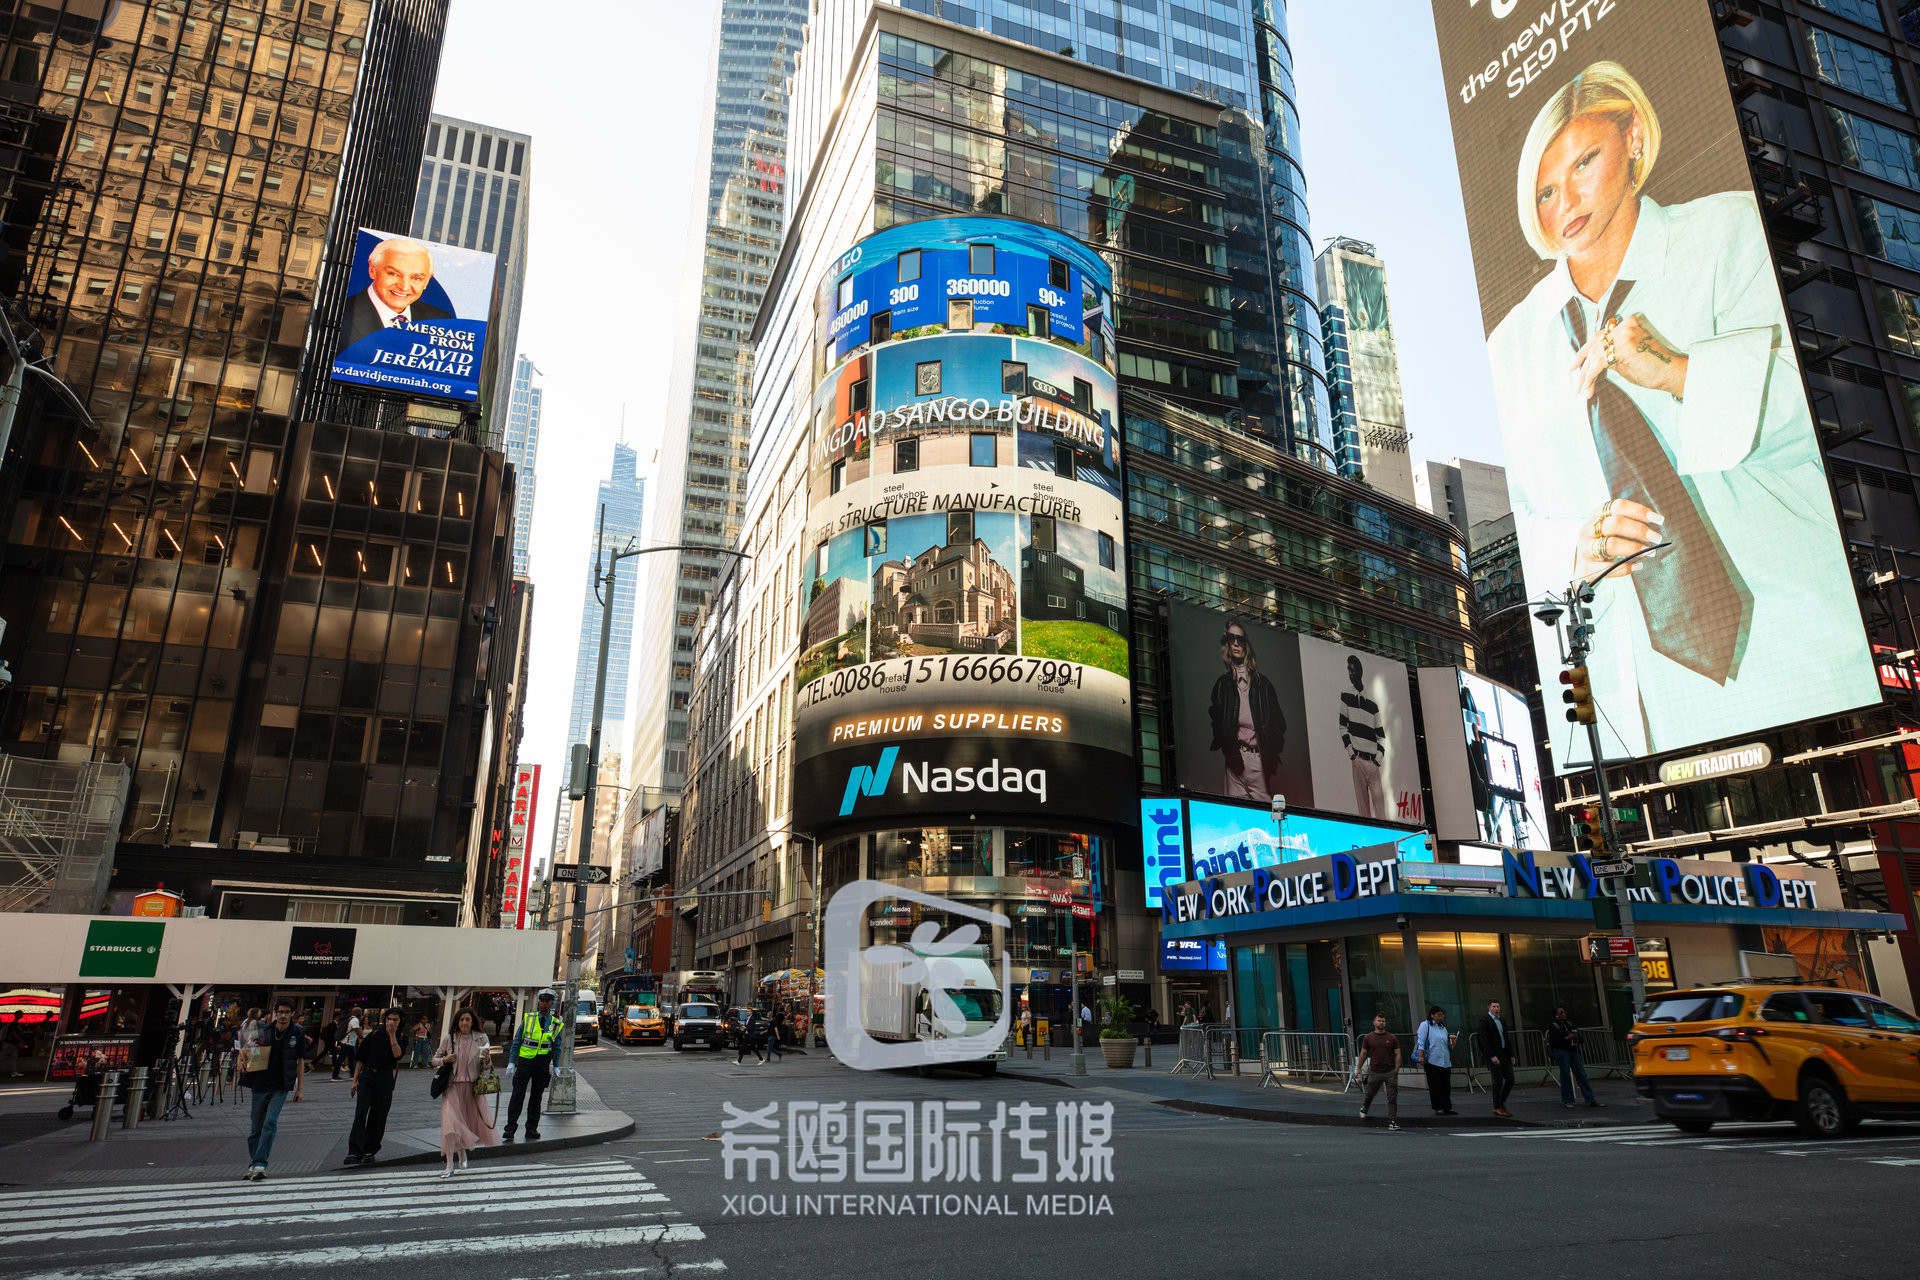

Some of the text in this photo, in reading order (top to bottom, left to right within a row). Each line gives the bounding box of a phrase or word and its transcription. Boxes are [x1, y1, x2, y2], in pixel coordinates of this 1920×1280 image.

[1559, 0, 1616, 51] PT2
[1460, 2, 1557, 104] the new
[890, 284, 919, 306] 300
[946, 278, 1010, 297] 360000
[1038, 287, 1066, 307] 90+
[829, 300, 868, 335] 480000
[391, 319, 475, 342] A MESSAGE
[409, 343, 474, 365] DAVID
[429, 336, 474, 351] FROM
[369, 349, 472, 377] JEREMIAH
[810, 397, 1105, 472] QINGDAO SANGO BUILDING
[883, 482, 905, 494] steel
[883, 490, 926, 504] workshop
[1033, 482, 1054, 492] steel
[1033, 491, 1075, 507] showroom
[839, 495, 928, 532] STRUCTURE
[932, 493, 1081, 523] MANUFACTURER
[902, 656, 1083, 689] 15166667991
[880, 684, 907, 694] house
[1038, 683, 1064, 694] house
[833, 713, 1063, 742] PREMIUM SUPPLIERS
[902, 758, 1047, 803] Nasdaq
[513, 772, 531, 825] PARK
[1397, 791, 1421, 822] H&M
[1502, 848, 1576, 898] NEW
[1656, 858, 1750, 907] POLICE
[1753, 864, 1818, 909] DEPT
[1595, 863, 1628, 875] ONE WAY
[504, 857, 521, 912] PARK
[1160, 852, 1398, 924] NEW YORK POLICE DEPT
[1026, 906, 1047, 914] Nasdaq
[89, 945, 142, 953] STARBUCKS
